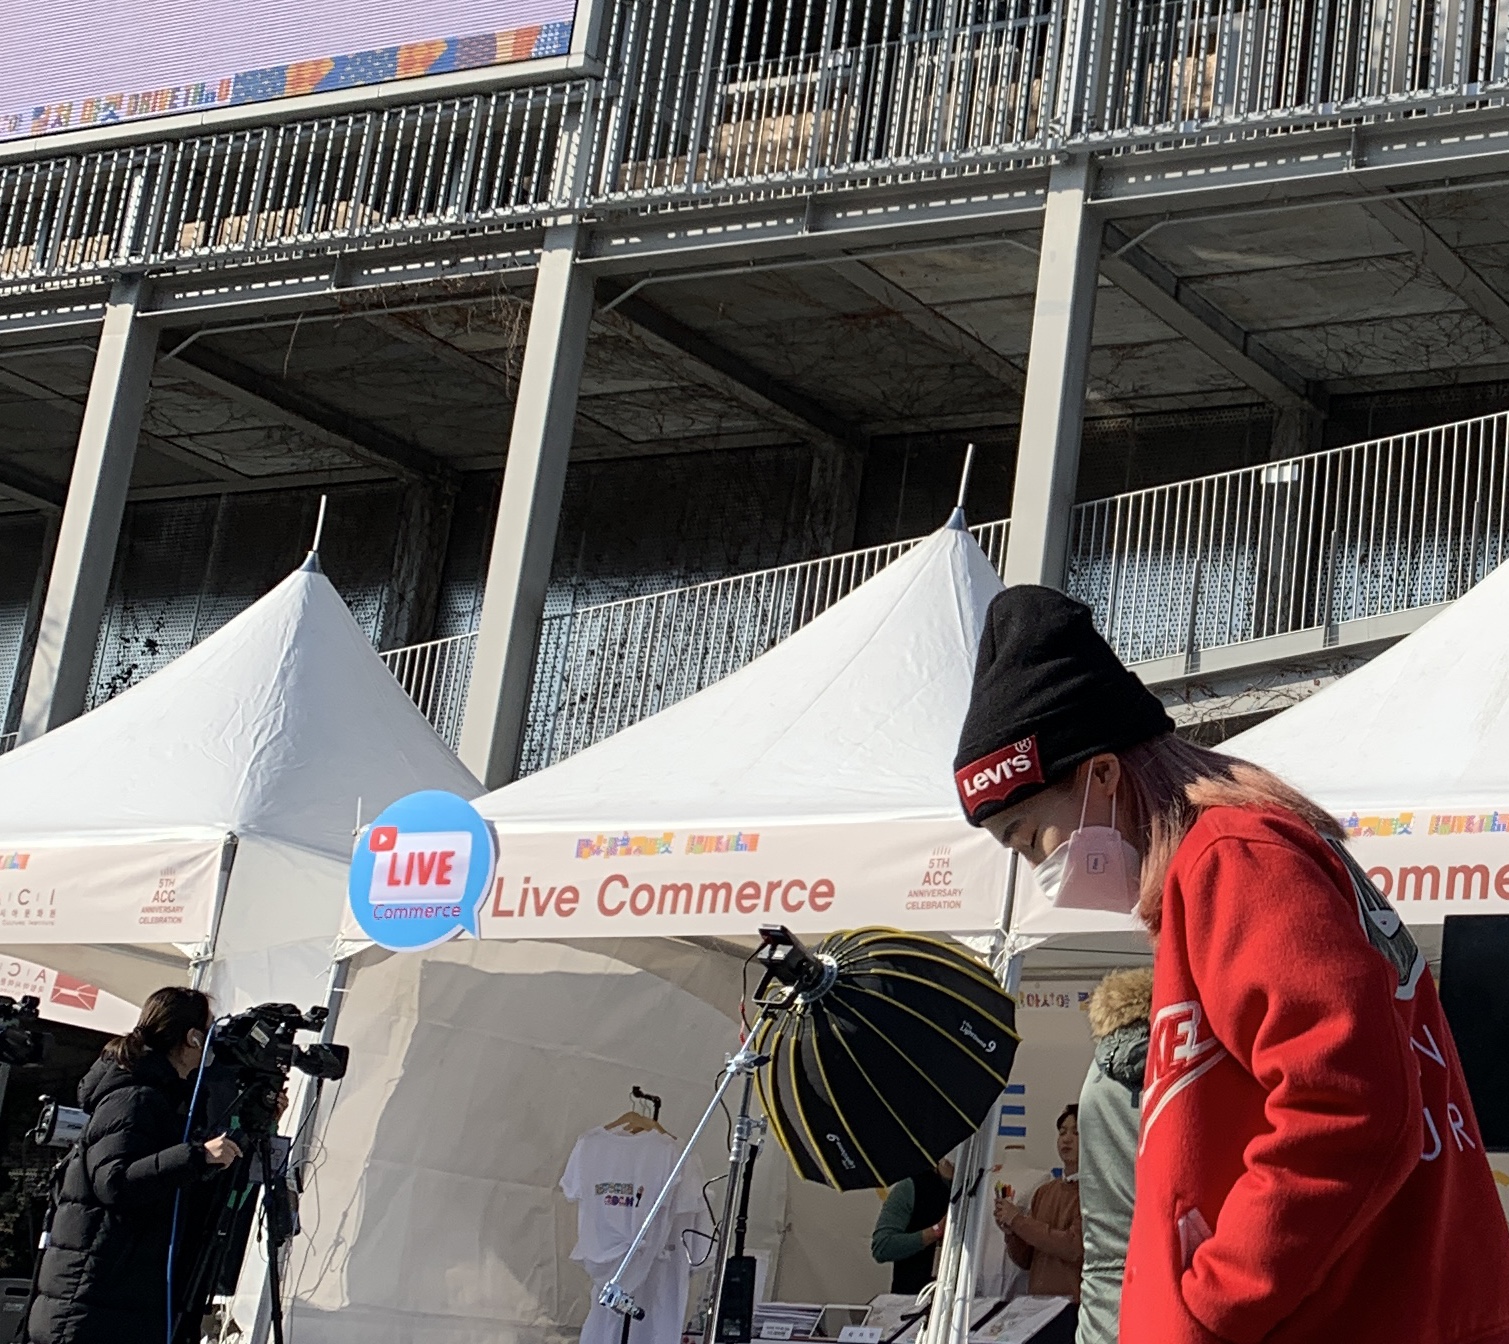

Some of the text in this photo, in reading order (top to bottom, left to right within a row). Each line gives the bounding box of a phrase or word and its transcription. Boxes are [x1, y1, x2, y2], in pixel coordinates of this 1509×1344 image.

[387, 851, 456, 887] LIVE
[928, 858, 950, 869] 5TH
[158, 878, 176, 889] 5TH
[921, 870, 953, 886] ACC
[152, 889, 176, 904] ACC
[491, 873, 836, 918] Live Commerce
[907, 887, 964, 898] ANNIVERSARY
[373, 904, 462, 921] Commerce
[905, 899, 962, 911] CELEBRATION
